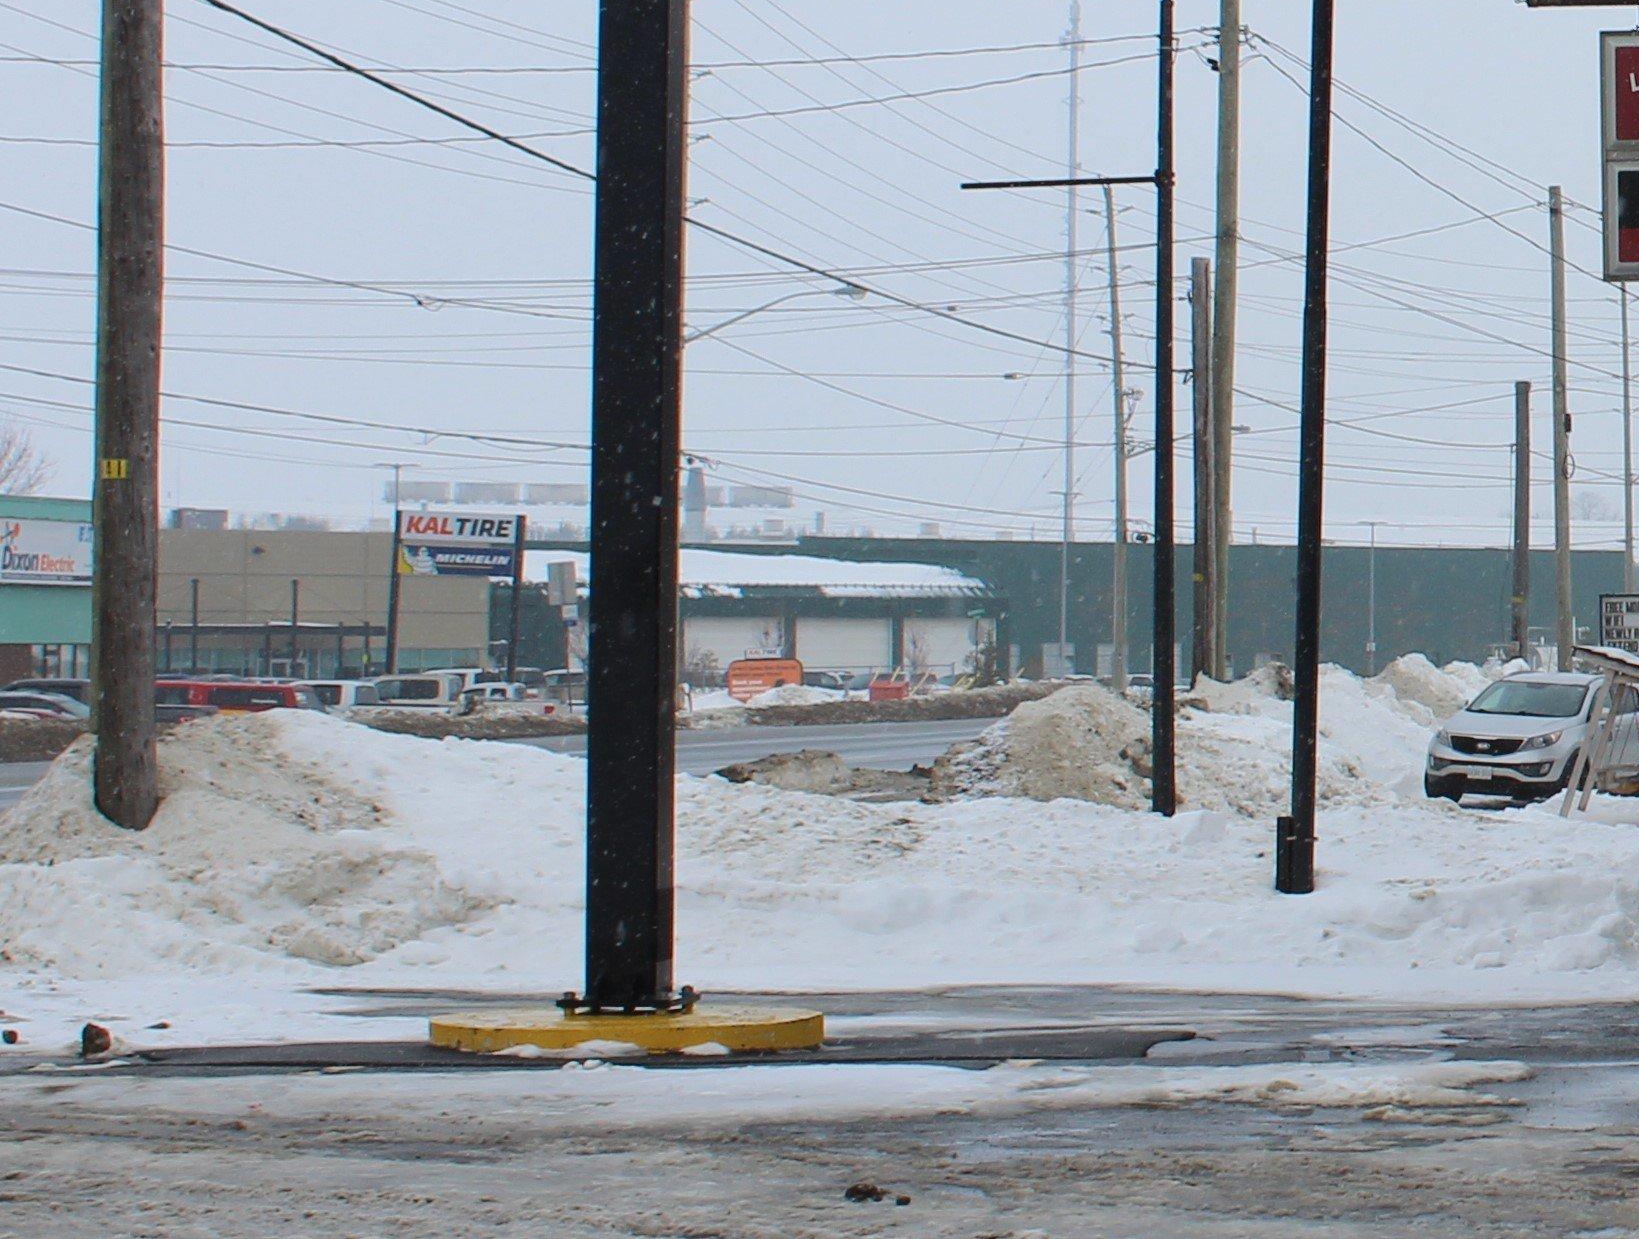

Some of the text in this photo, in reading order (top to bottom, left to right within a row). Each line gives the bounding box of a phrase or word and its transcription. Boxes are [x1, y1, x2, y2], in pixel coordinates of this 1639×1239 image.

[406, 515, 513, 538] KAL TIRE
[435, 554, 511, 566] MICHELIN
